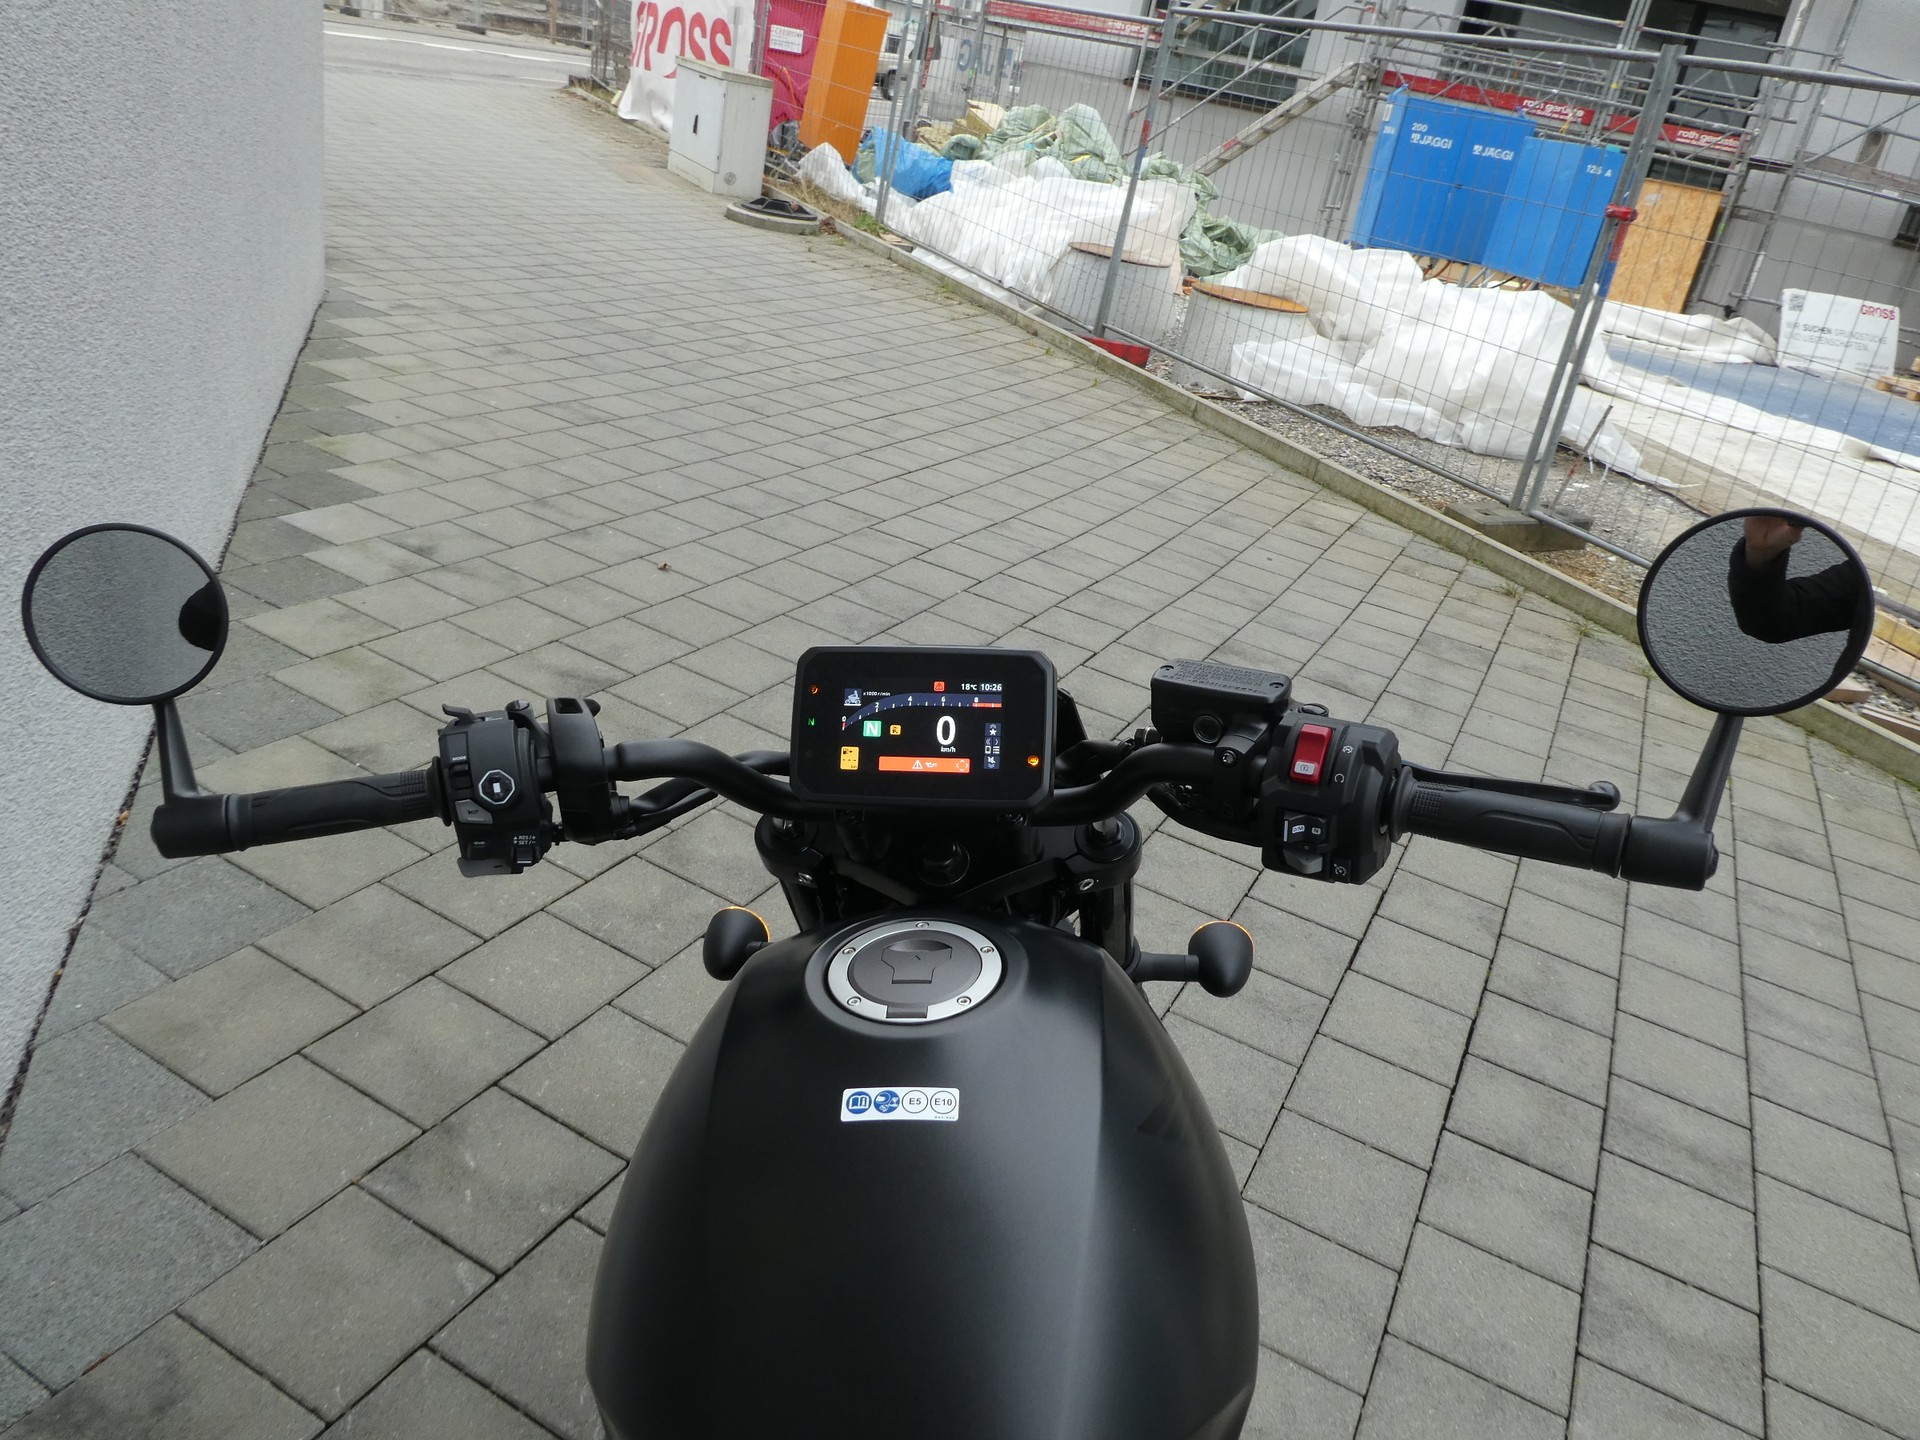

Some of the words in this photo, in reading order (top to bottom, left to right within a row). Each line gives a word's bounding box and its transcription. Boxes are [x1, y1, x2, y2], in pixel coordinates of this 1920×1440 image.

[1523, 99, 1544, 109] roh
[1545, 103, 1585, 117] gerüse
[1412, 122, 1428, 132] 200
[1677, 130, 1699, 139] roth
[1604, 169, 1613, 177] A
[1861, 304, 1896, 320] GROSS
[1803, 324, 1831, 334] SUCHEN
[980, 683, 1003, 691] 10:26
[807, 718, 815, 726] N
[866, 722, 878, 735] N
[935, 715, 957, 745] 0
[934, 1098, 953, 1106] E10
